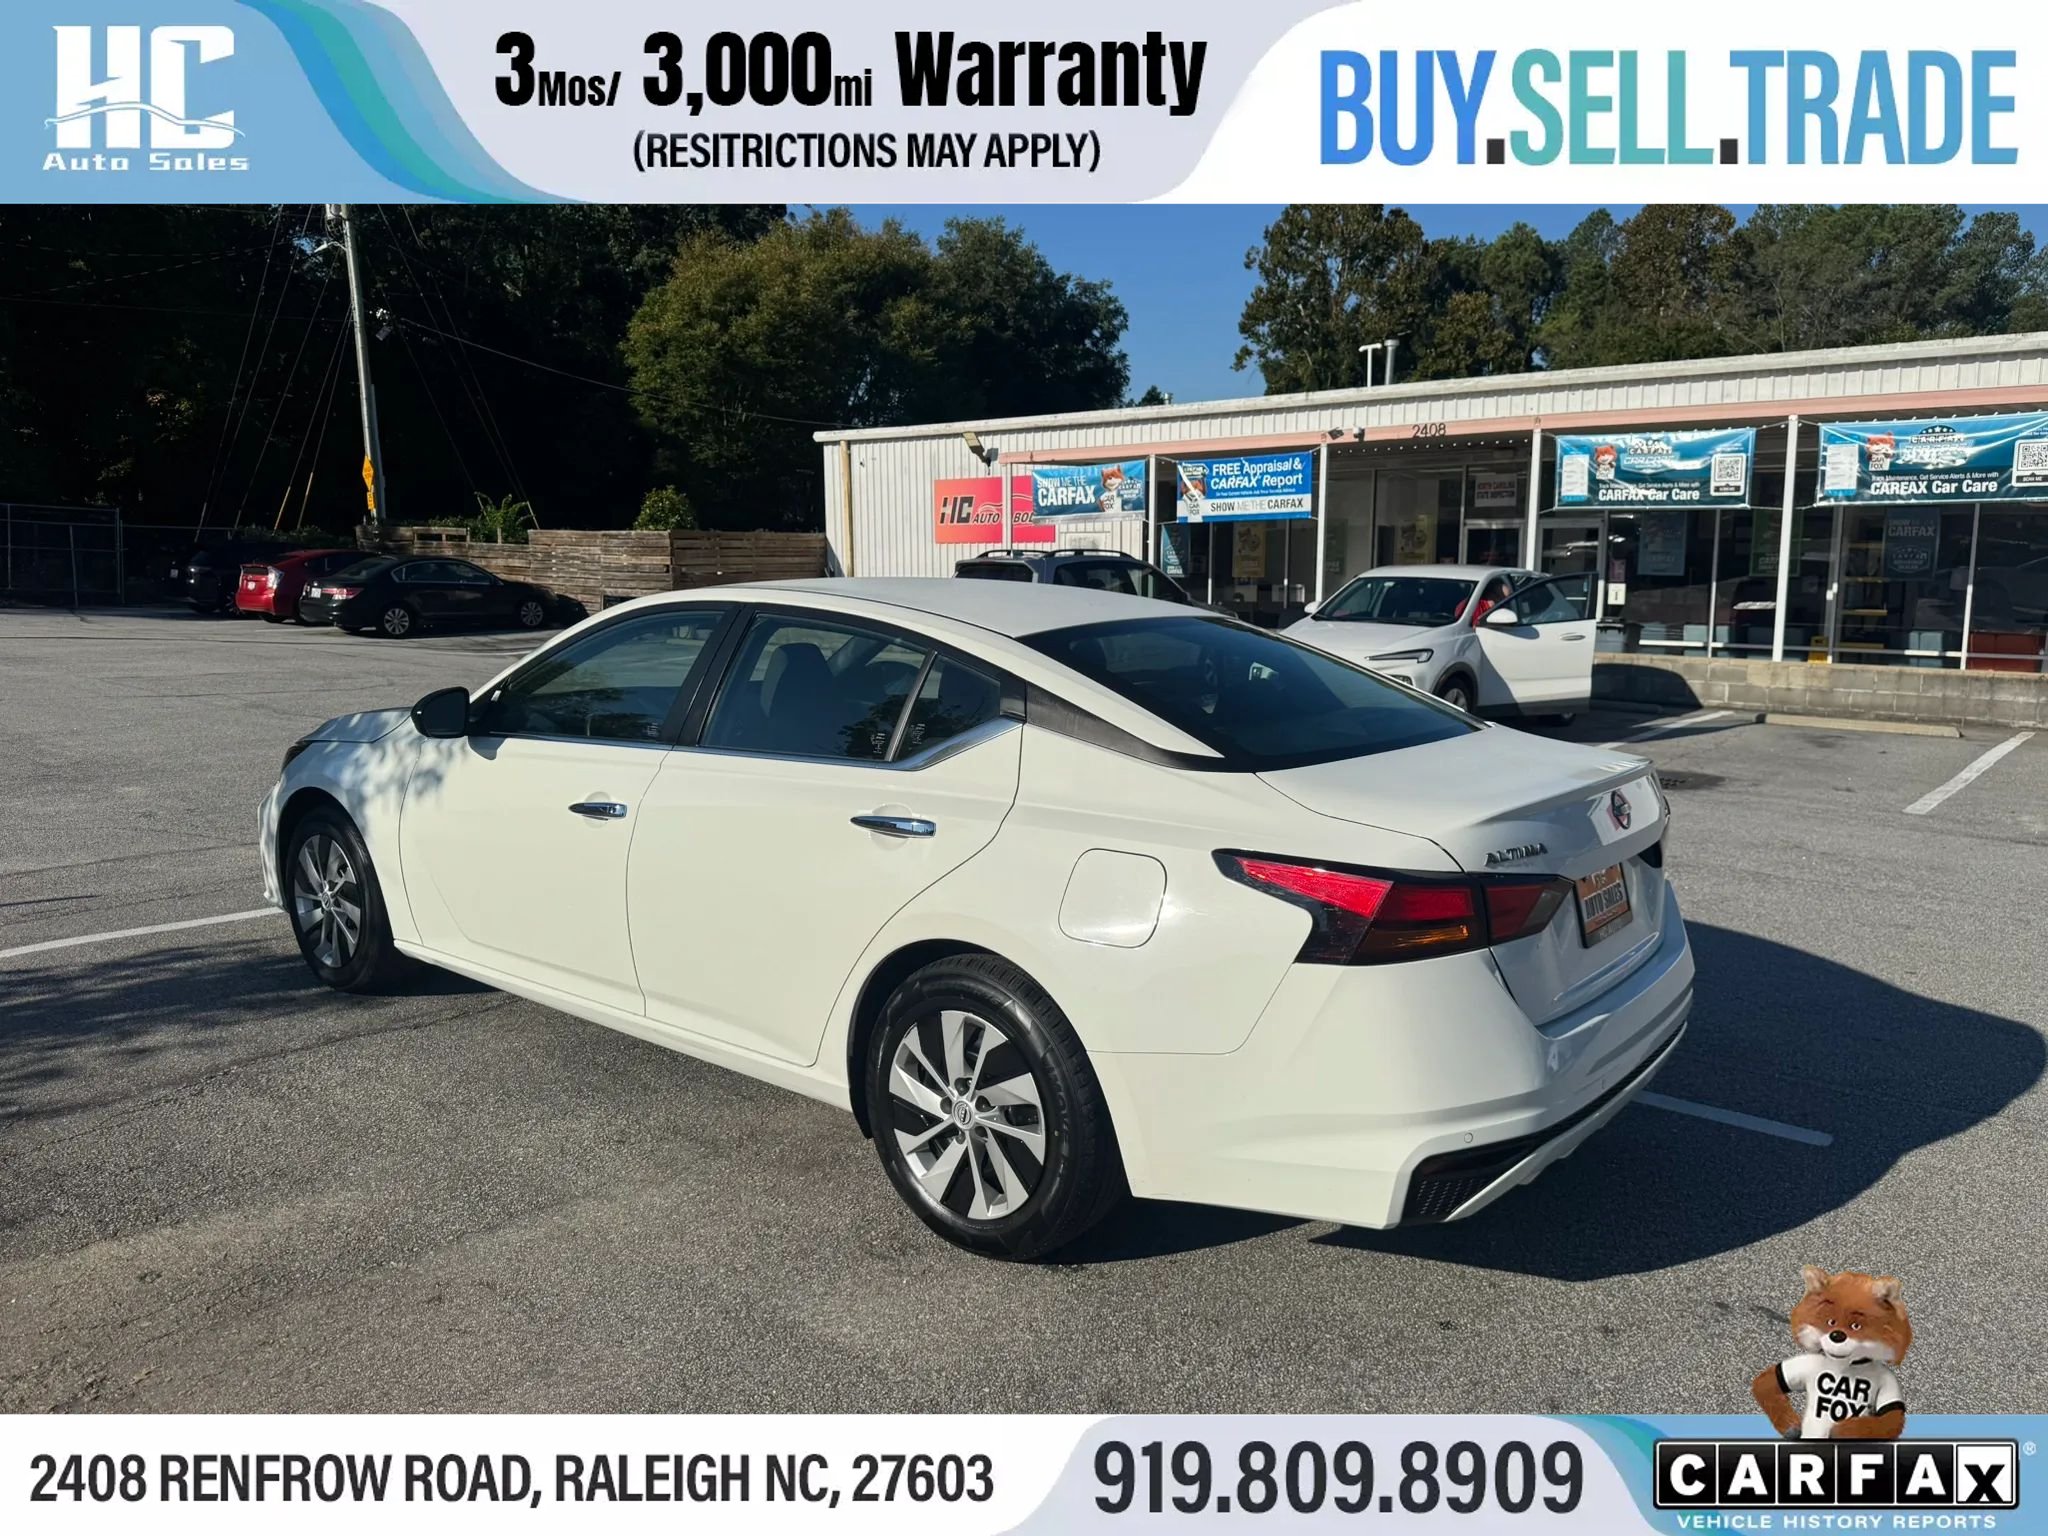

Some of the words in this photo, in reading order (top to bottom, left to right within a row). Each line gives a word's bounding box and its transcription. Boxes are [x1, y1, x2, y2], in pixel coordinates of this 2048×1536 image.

[1412, 422, 1447, 438] 2408
[1212, 463, 1242, 476] FREE
[1243, 458, 1292, 478] Appraisal
[1293, 457, 1304, 470] &
[1061, 477, 1073, 487] ME
[1074, 475, 1087, 486] THE
[1211, 476, 1259, 489] CARFAX
[1262, 473, 1303, 488] Report
[1870, 481, 1928, 495] CARFAX
[1931, 480, 1959, 494] Car
[1962, 479, 1998, 493] Care
[1037, 485, 1096, 506] CARFAX
[1598, 488, 1645, 501] CARFAX
[1647, 488, 1670, 501] Car
[1671, 487, 1701, 501] Care
[939, 496, 975, 524] HC
[972, 512, 1000, 523] AUTO
[1210, 501, 1236, 512] SHOW
[1267, 498, 1304, 510] CARFAX
[1483, 842, 1549, 867] ALTIMA
